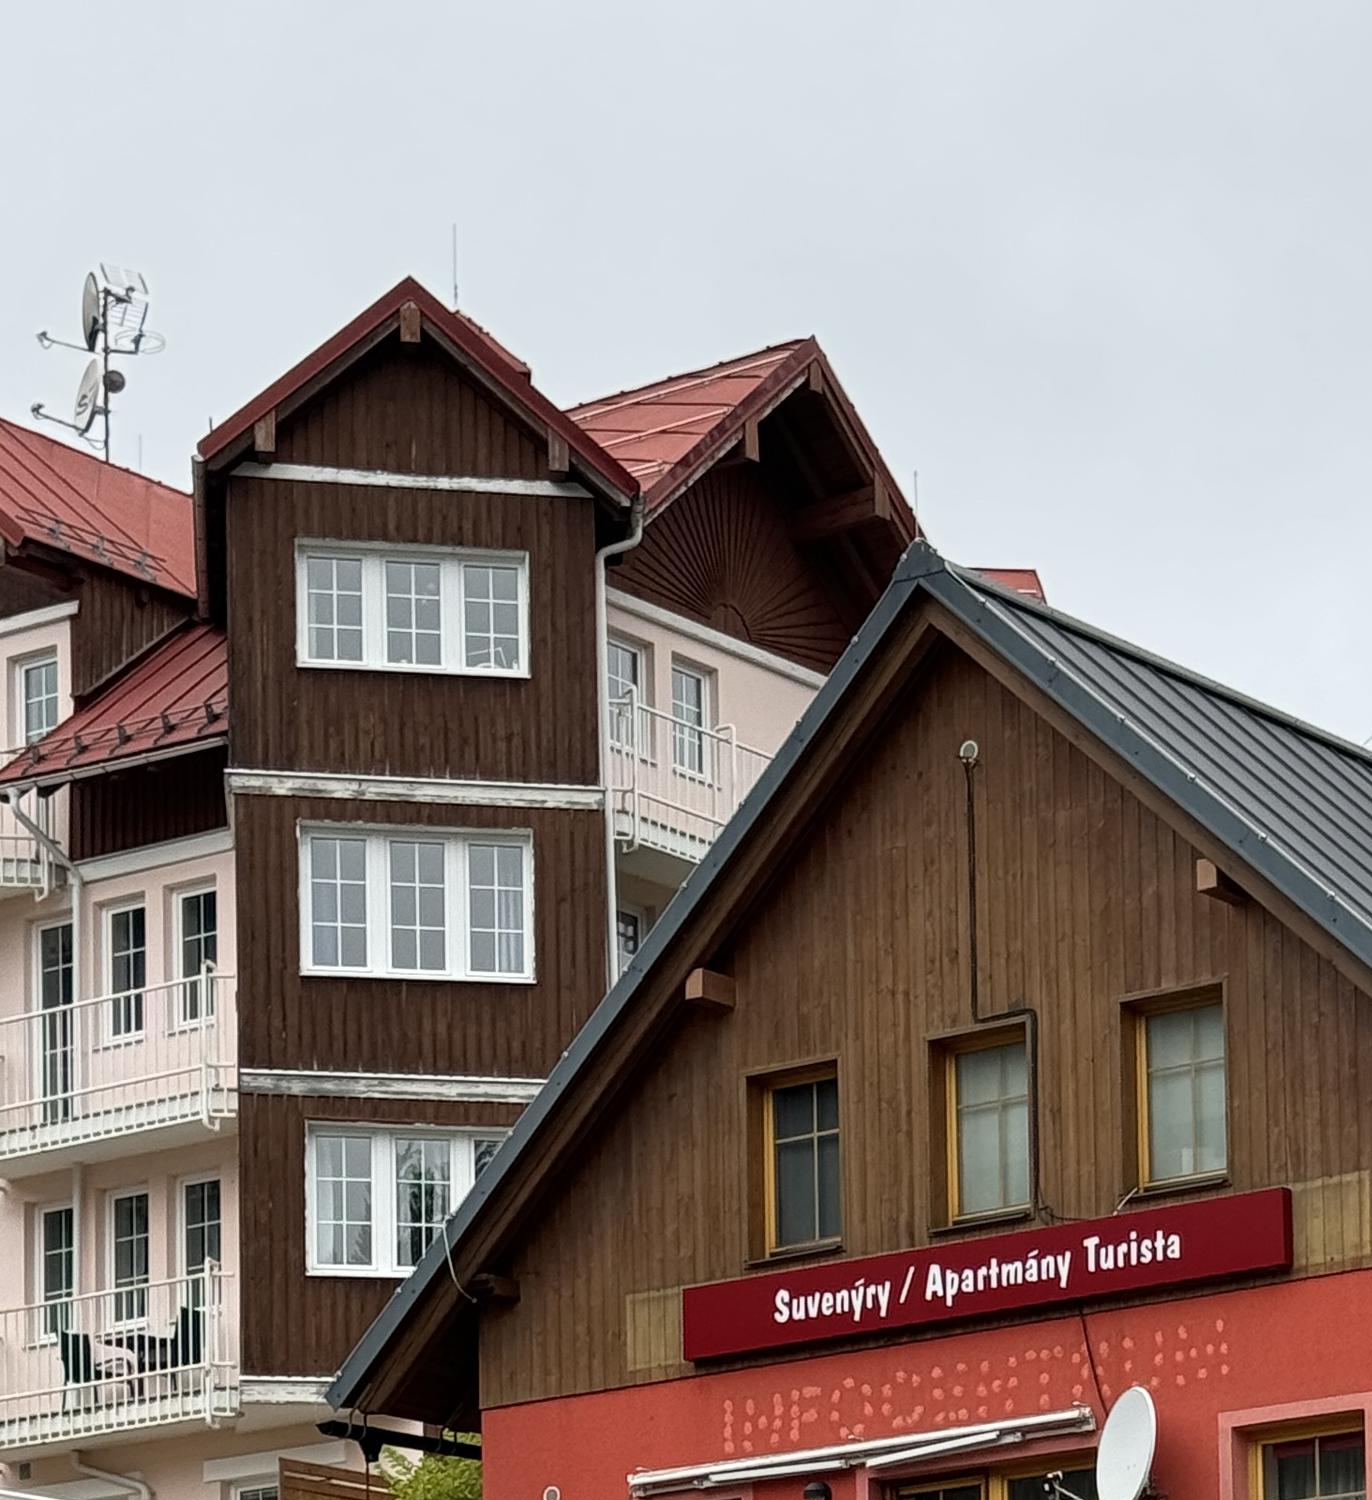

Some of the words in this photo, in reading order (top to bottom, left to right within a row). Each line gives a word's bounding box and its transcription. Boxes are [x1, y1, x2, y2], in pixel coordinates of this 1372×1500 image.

[774, 1277, 891, 1324] Suvenýry
[899, 1265, 915, 1304] /
[925, 1249, 1072, 1306] Apartmány
[1083, 1230, 1182, 1273] Turista
